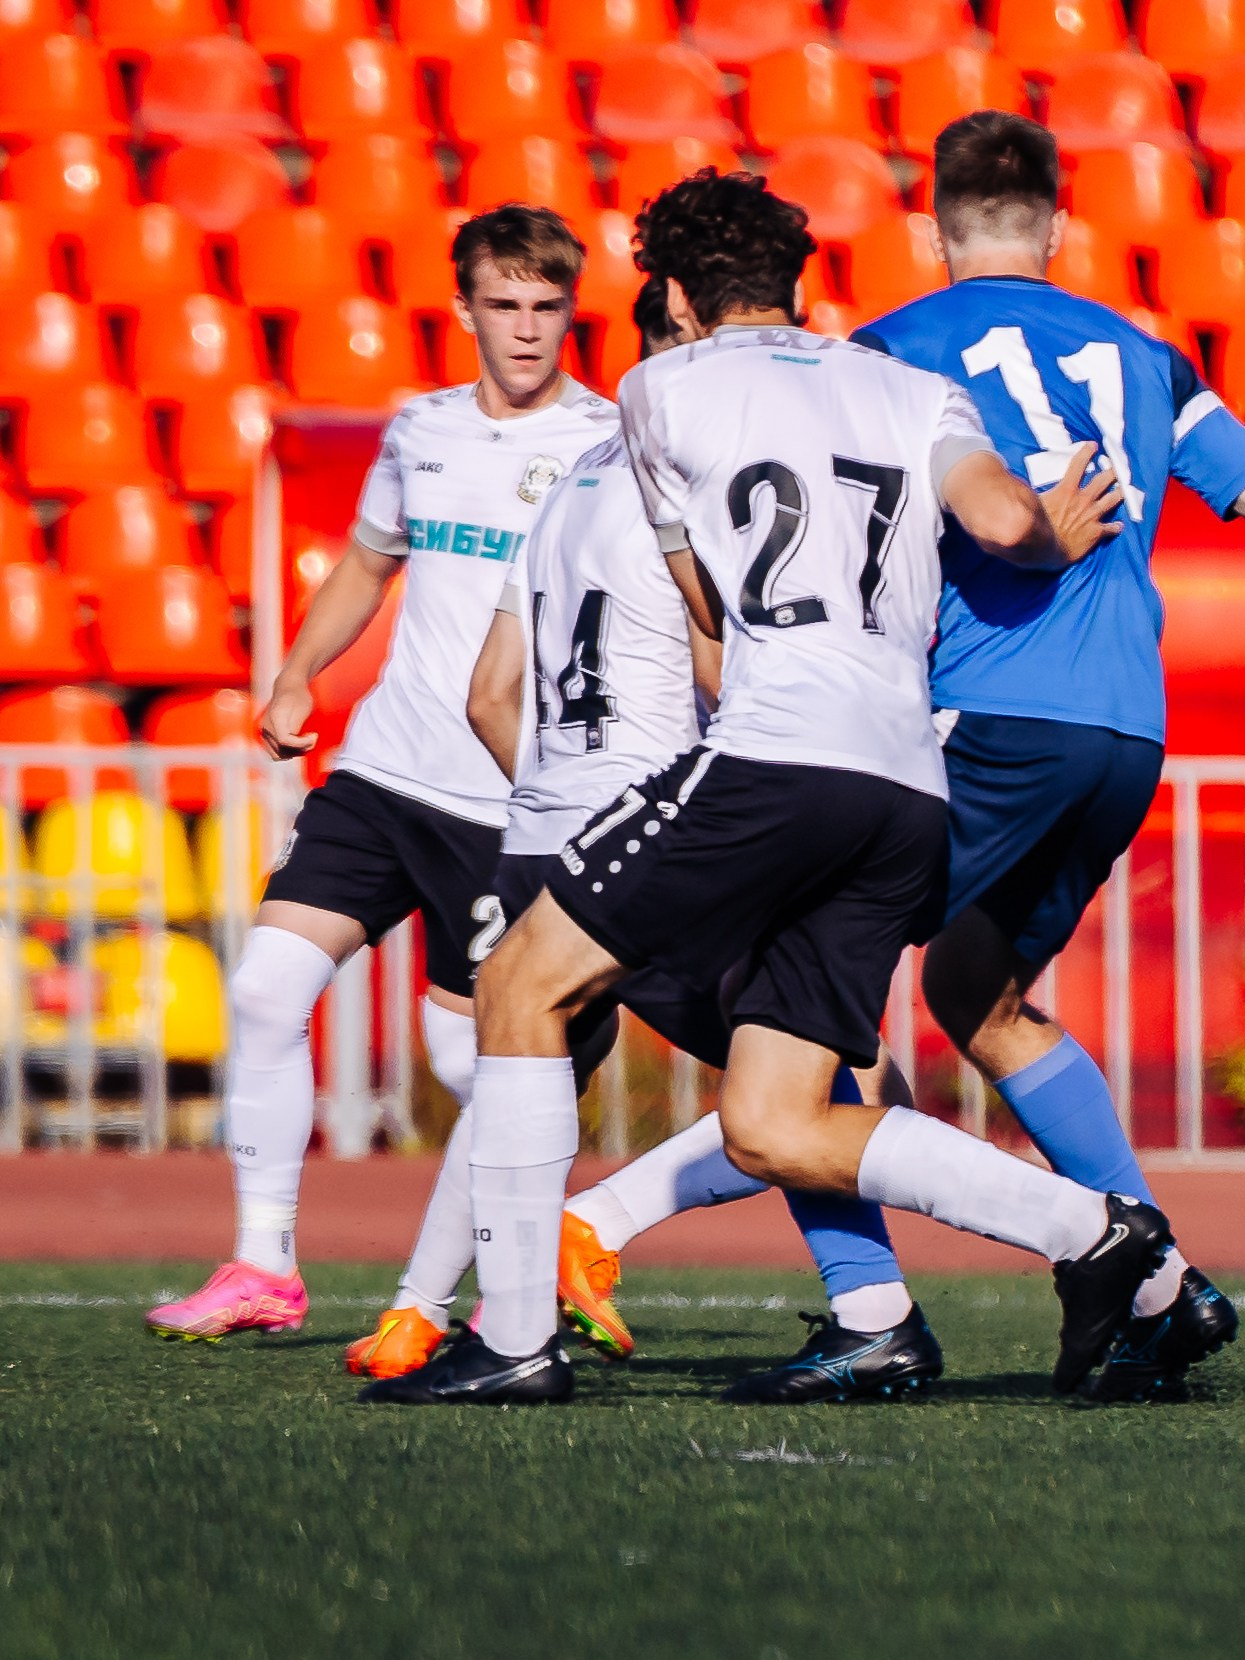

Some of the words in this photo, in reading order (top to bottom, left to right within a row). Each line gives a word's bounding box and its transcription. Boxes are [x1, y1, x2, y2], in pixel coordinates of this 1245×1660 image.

[414, 460, 444, 474] JAKO
[960, 325, 1146, 523] 11
[726, 452, 911, 636] 27
